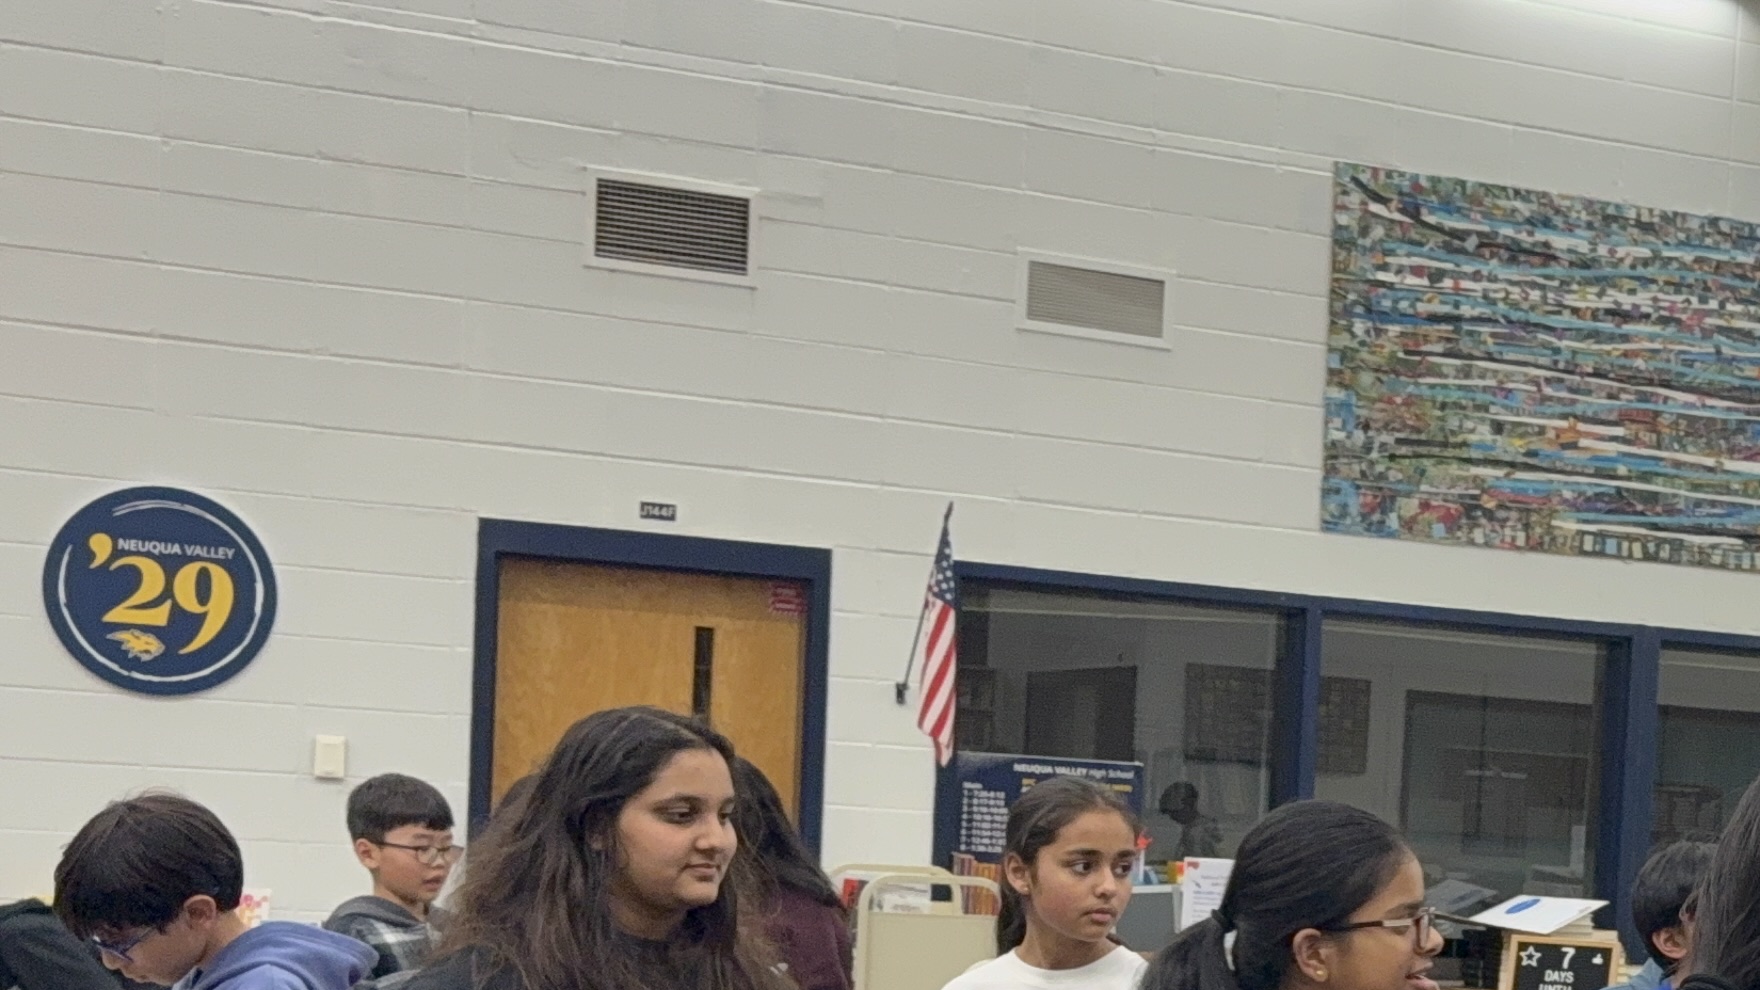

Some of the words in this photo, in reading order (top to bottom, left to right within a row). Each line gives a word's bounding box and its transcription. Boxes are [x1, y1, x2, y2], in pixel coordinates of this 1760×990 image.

[117, 538, 182, 556] NEUQUA
[183, 544, 236, 559] VALLEY
[88, 532, 235, 655] '29
[1055, 765, 1089, 776] VALLEY
[1561, 946, 1576, 969] 7
[1544, 969, 1575, 983] DAYS
